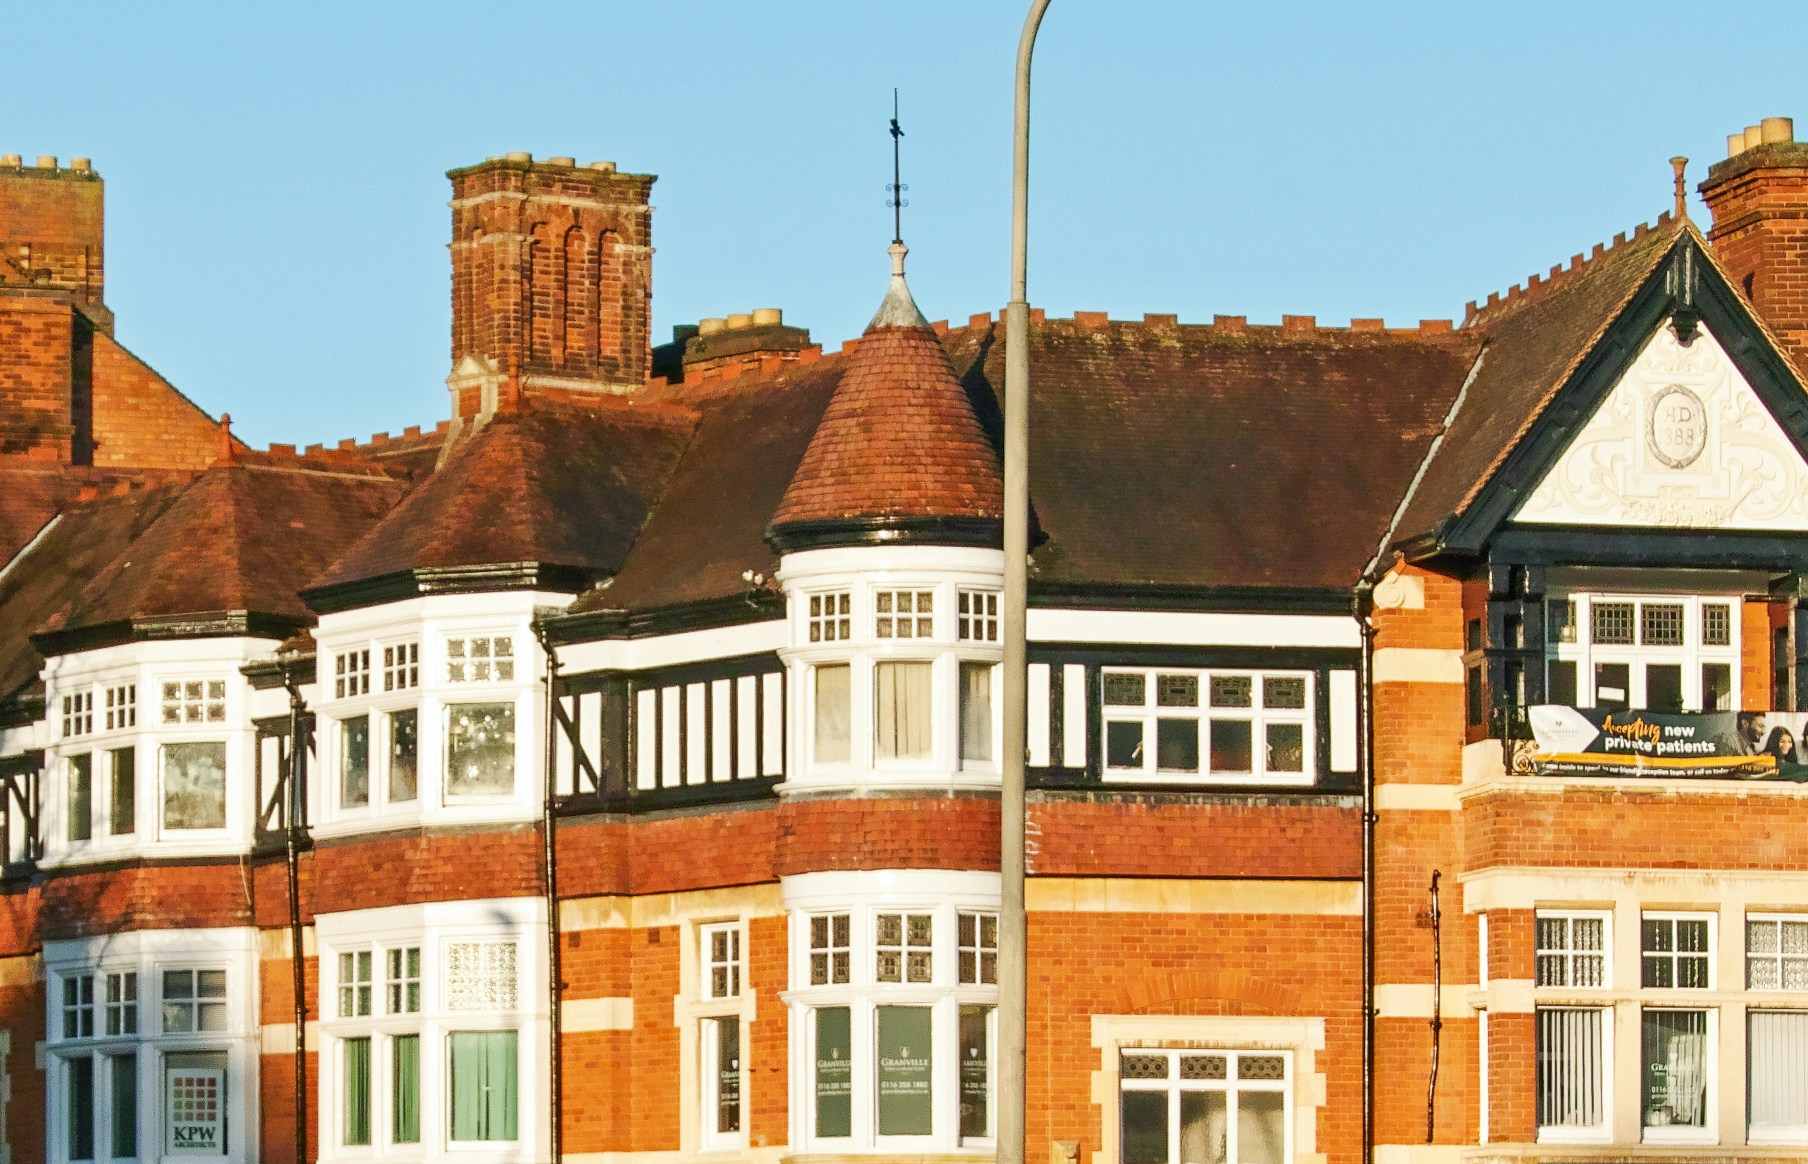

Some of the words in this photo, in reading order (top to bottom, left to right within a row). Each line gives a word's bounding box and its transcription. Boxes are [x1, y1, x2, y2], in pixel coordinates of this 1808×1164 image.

[1602, 714, 1661, 745] Accepting
[1665, 725, 1695, 737] new
[1604, 735, 1653, 752] private
[1656, 738, 1716, 756] patients
[880, 1057, 929, 1066] GRANVILLE
[174, 1126, 216, 1141] KPW
